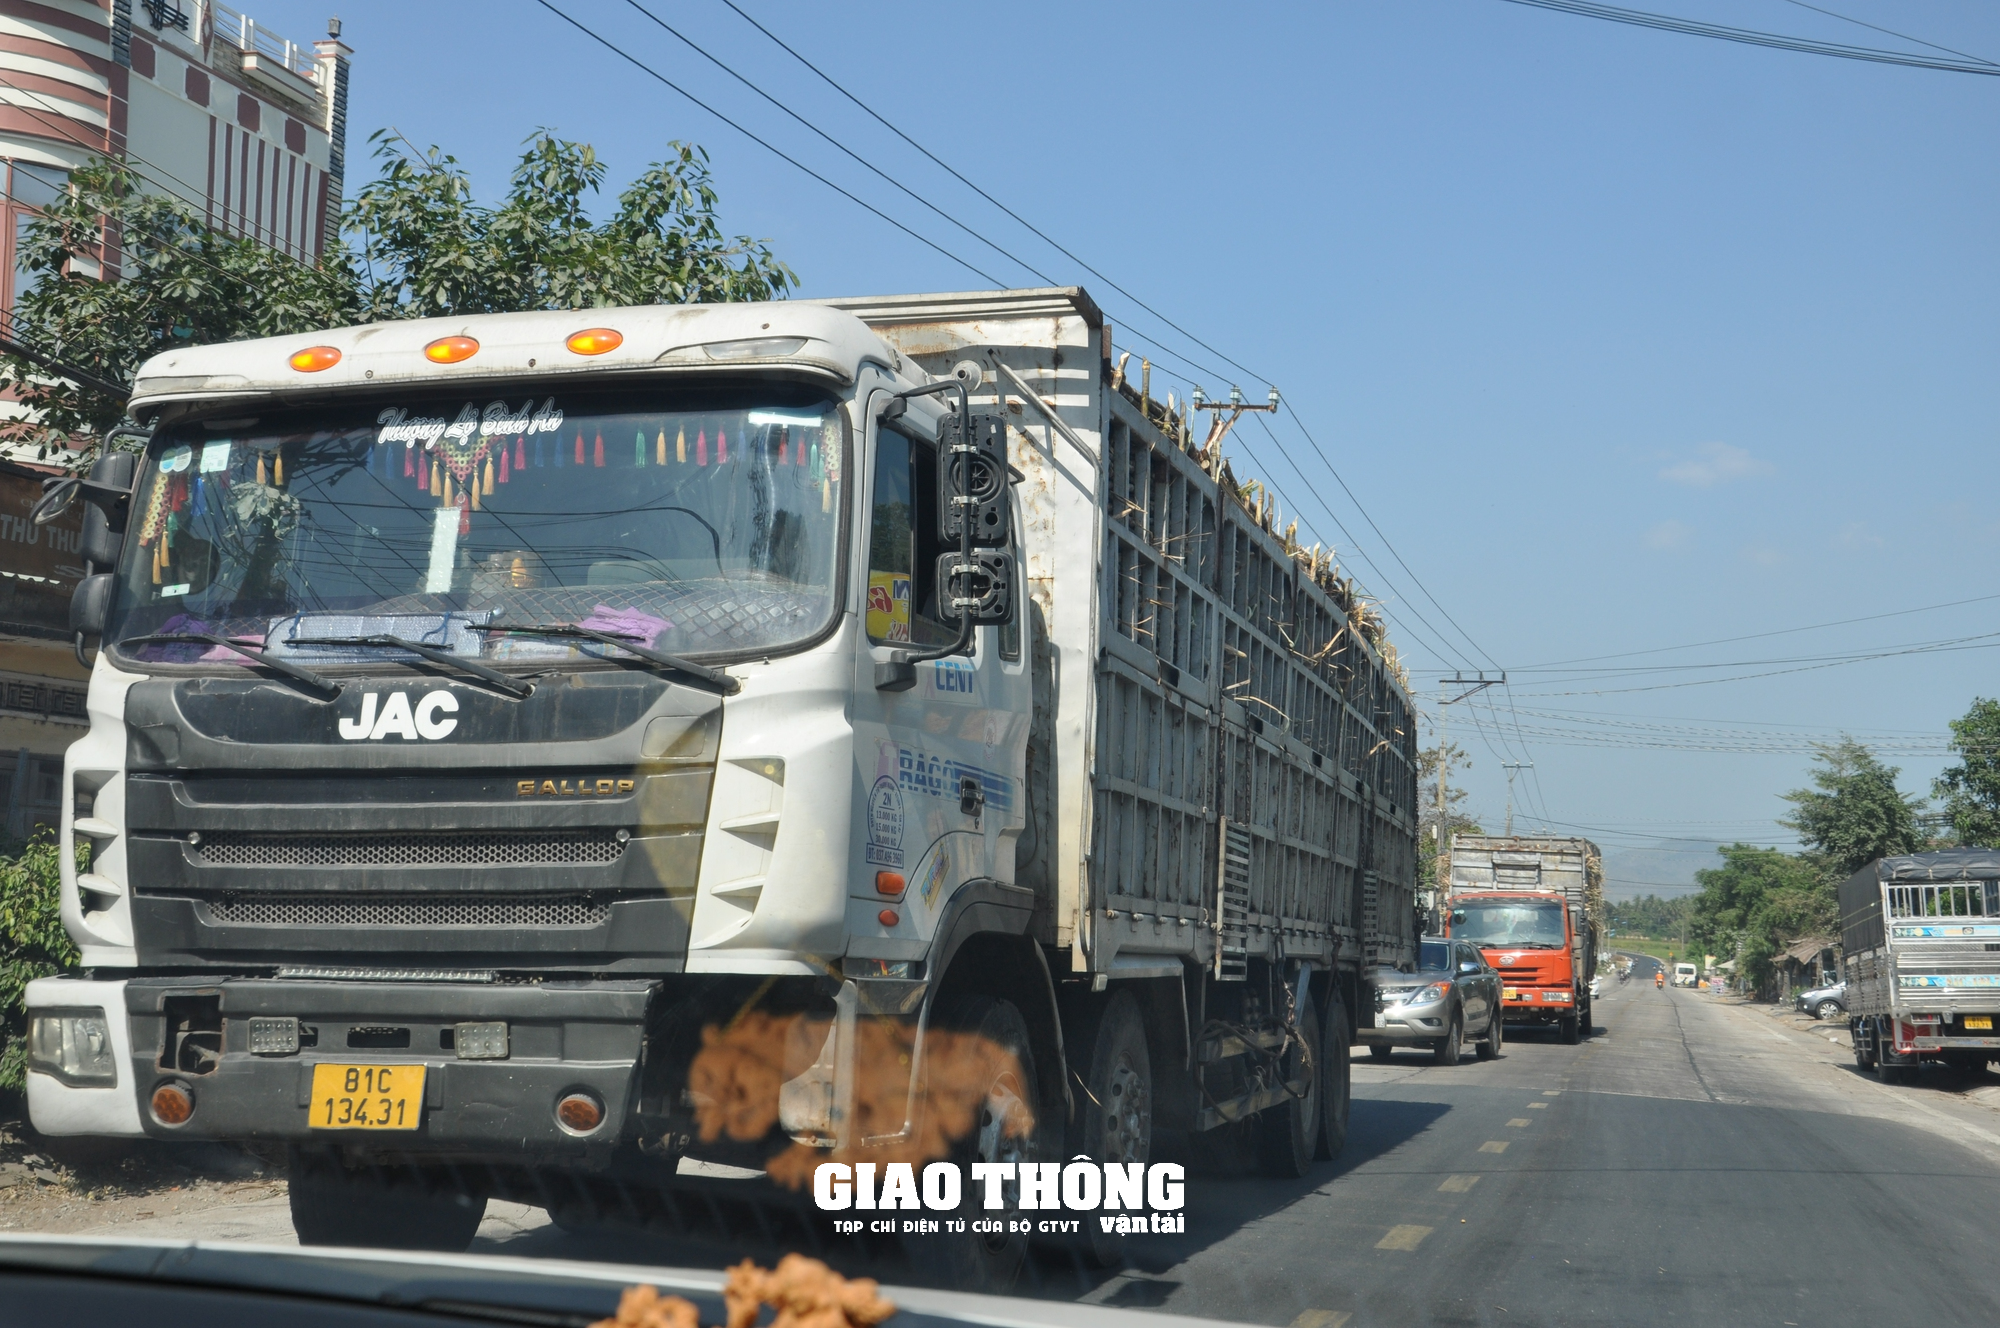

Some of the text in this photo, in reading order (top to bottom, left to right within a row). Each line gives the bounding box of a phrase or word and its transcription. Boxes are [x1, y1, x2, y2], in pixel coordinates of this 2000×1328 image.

[528, 397, 563, 434] An
[338, 689, 459, 740] JAC
[517, 779, 635, 796] GALLOP
[882, 792, 892, 807] 2N
[344, 1067, 392, 1094] 81C
[325, 1097, 406, 1126] 134.31
